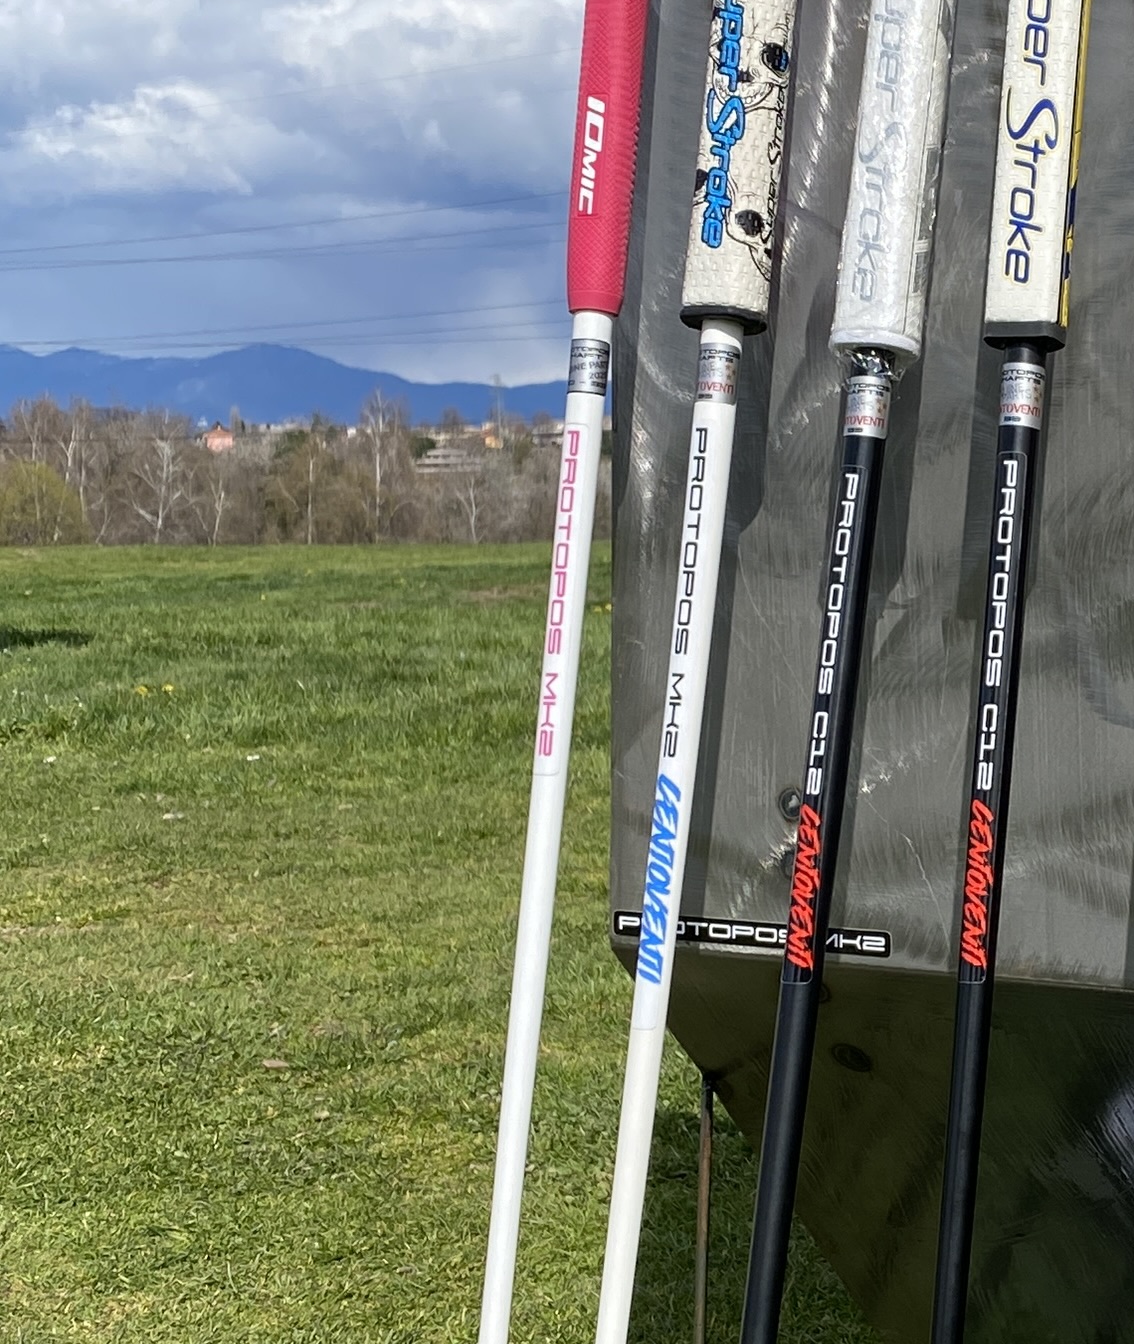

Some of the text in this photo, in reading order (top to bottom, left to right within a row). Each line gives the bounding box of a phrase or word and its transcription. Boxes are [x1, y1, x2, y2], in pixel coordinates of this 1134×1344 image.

[578, 95, 606, 215] IOMIC
[699, 87, 747, 249] Stroke
[851, 111, 908, 302] Stroke
[1004, 84, 1059, 284] Stroke
[537, 430, 580, 757] PROTOPOS MK2
[675, 427, 709, 655] PROTOPOS
[805, 472, 859, 795] PROTOPOS C1.2
[976, 460, 1017, 791] PROTOPOS C1.2
[662, 673, 684, 758] MK2
